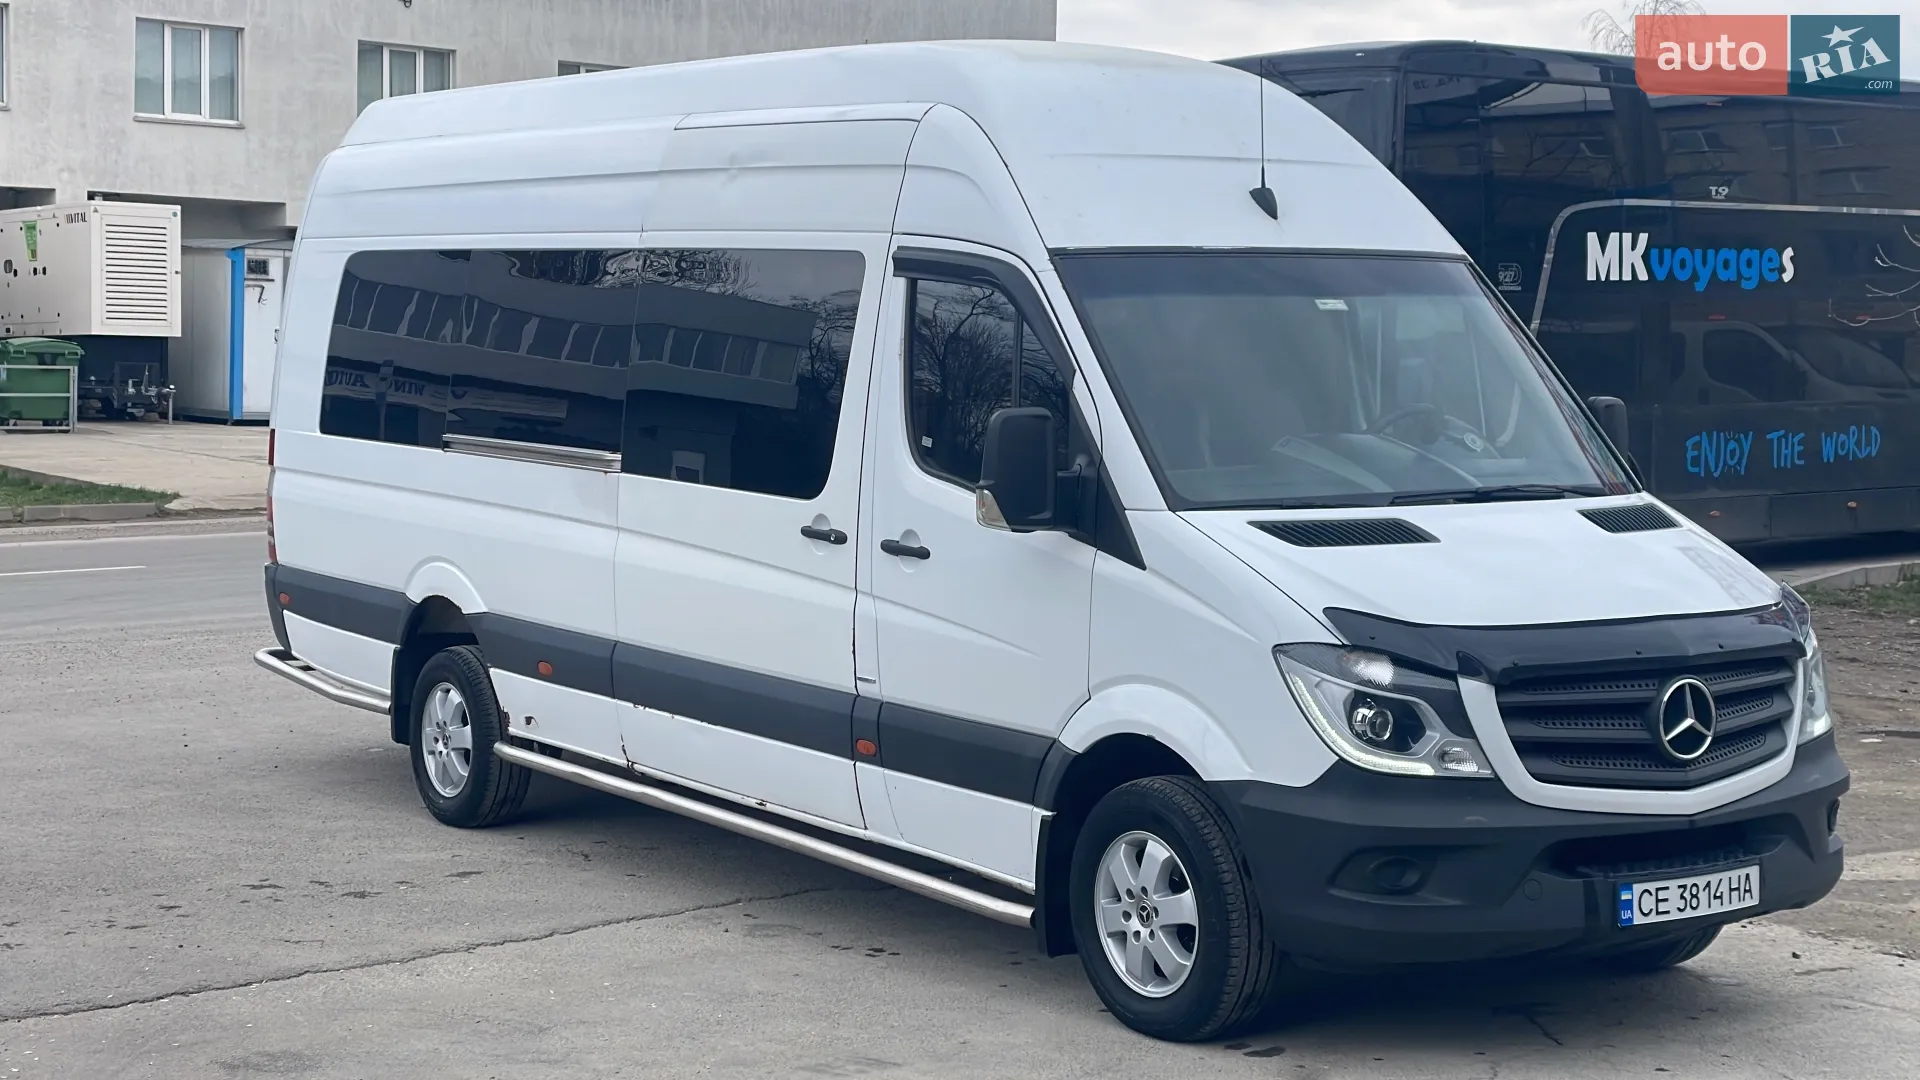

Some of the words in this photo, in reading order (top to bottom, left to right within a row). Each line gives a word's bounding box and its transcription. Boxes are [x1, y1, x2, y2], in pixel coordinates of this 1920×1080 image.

[1685, 431, 1753, 477] ENJOY
[1766, 429, 1805, 468] THE
[1821, 424, 1881, 463] WORLD
[1621, 910, 1633, 919] UA
[1638, 886, 1671, 917] CE
[1676, 878, 1724, 912] 3814
[1728, 872, 1754, 905] HA
